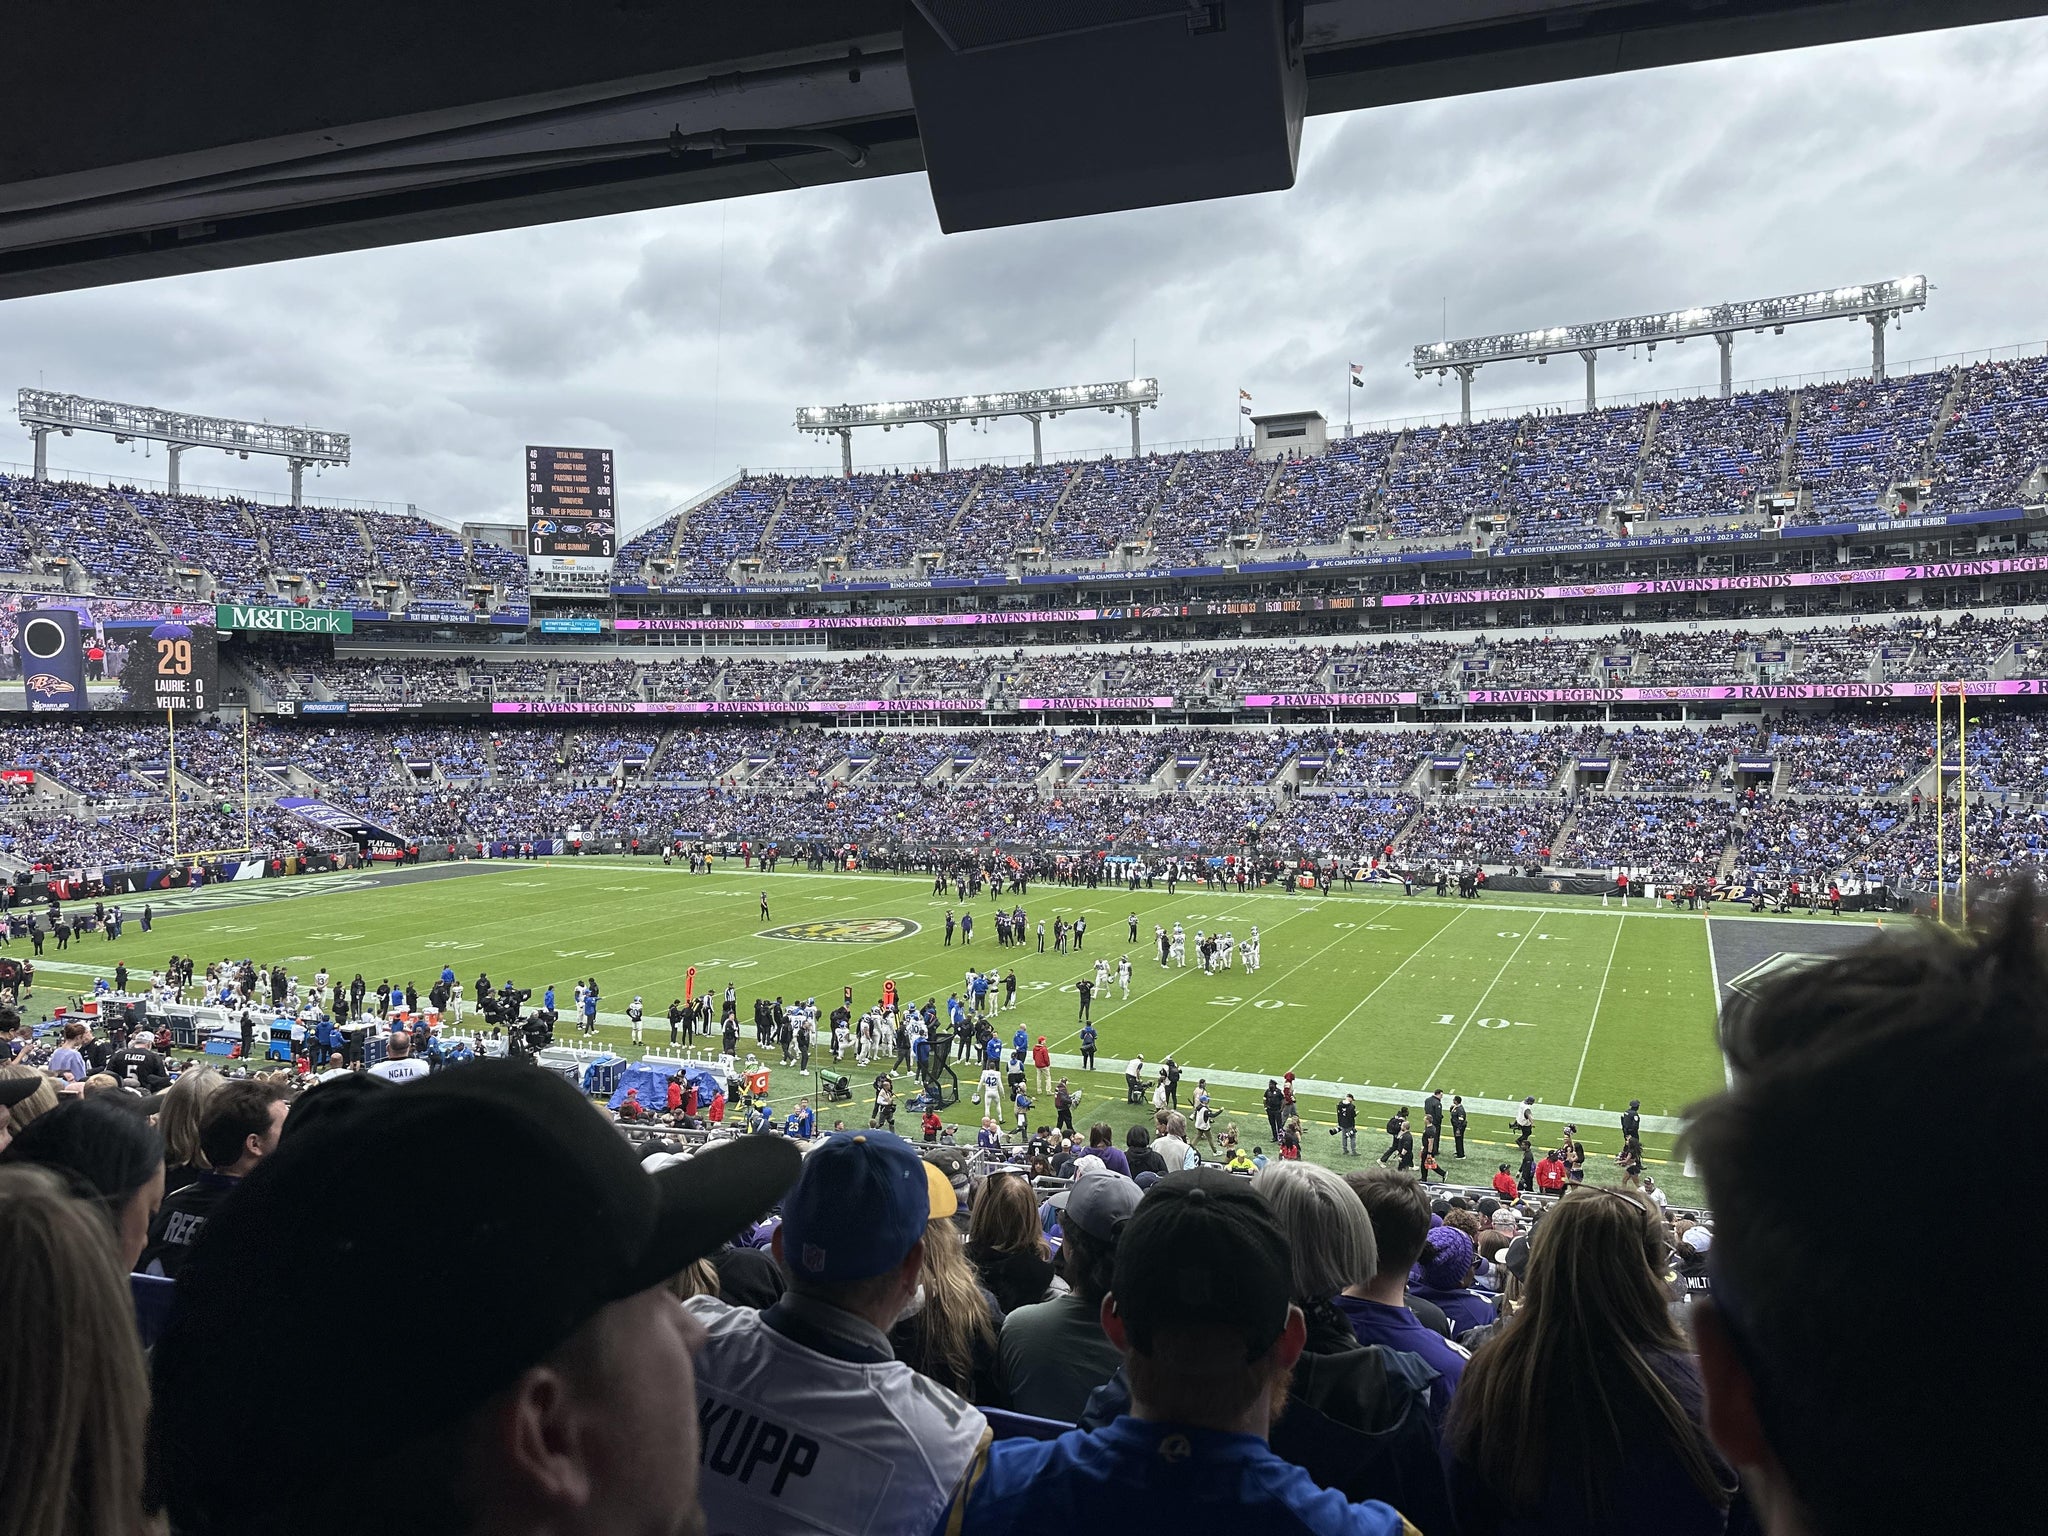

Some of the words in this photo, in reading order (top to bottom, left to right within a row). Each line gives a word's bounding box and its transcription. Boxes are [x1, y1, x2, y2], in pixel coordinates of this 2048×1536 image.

[530, 450, 537, 458] 46
[530, 461, 536, 469] 15
[602, 464, 610, 472] 72
[530, 473, 537, 481] 31
[604, 476, 610, 484] 12
[531, 484, 542, 492] 2/10
[576, 486, 590, 494] YARDS
[597, 487, 610, 495] 3/30
[551, 508, 561, 516] TIME
[566, 508, 592, 516] POSSESSION
[1858, 523, 1876, 532] THANK
[1878, 522, 1888, 530] YOU
[1890, 520, 1921, 530] FRONTLINE
[1922, 517, 1947, 528] HEROES!
[534, 538, 542, 553] 0
[603, 540, 610, 555] 3
[1545, 544, 1583, 552] CHAMPIONS
[1904, 568, 1916, 579] 2
[1924, 562, 1993, 578] RAVENS
[1998, 556, 2048, 574] LEGE
[1811, 573, 1840, 584] PASS
[1851, 570, 1886, 582] CASH
[1637, 583, 1648, 593] 2
[1653, 579, 1713, 592] RAVENS
[1718, 575, 1792, 590] LEGENDS
[1559, 586, 1586, 596] PASS
[1595, 584, 1624, 595] CASH
[1410, 595, 1419, 604] 2
[1423, 592, 1476, 604] RAVENS
[1480, 588, 1544, 601] LEGENDS
[1265, 602, 1282, 612] 15:00
[1283, 602, 1295, 611] QTR
[1296, 601, 1300, 610] 2
[1329, 598, 1354, 609] TIMEOUT
[1362, 597, 1375, 607] 1:35
[1126, 609, 1131, 617] 0
[1174, 607, 1178, 616] 3
[1222, 605, 1226, 614] 2
[1228, 604, 1239, 614] BALL
[1240, 604, 1248, 613] ON
[232, 607, 288, 630] M&T
[290, 611, 340, 632] Bank
[819, 618, 857, 627] RAVENS
[861, 617, 906, 626] LEGENDS
[986, 614, 1026, 623] RAVENS
[1030, 612, 1079, 621] LEGENDS
[650, 621, 692, 629] RAVENS
[696, 620, 744, 629] LEGENDS
[158, 640, 192, 675] 29
[155, 679, 190, 692] LAURIE:
[196, 679, 203, 693] 0
[1725, 687, 1736, 698] 2
[1742, 685, 1807, 699] RAVENS
[1812, 684, 1894, 697] LEGENDS
[2018, 681, 2032, 694] 2
[1271, 696, 1281, 705] 2
[1284, 695, 1334, 705] RAVENS
[1339, 693, 1400, 705] LEGENDS
[1476, 692, 1486, 702] 2
[1490, 690, 1548, 702] RAVENS
[1553, 688, 1623, 701] LEGENDS
[1639, 689, 1668, 699] PASS
[1678, 688, 1710, 698] CASH
[157, 696, 190, 709] VELITA:
[196, 696, 204, 709] 0
[279, 703, 292, 712] 25
[531, 704, 578, 712] RAVENS
[582, 704, 635, 712] LEGENDS
[718, 704, 759, 712] RAVENS
[762, 702, 810, 711] LEGENDS
[889, 701, 930, 710] RAVENS
[933, 700, 982, 710] LEGENDS
[1042, 700, 1050, 708] 2
[1054, 699, 1097, 708] RAVENS
[1101, 698, 1154, 708] LEGENDS
[1431, 1014, 1510, 1029] 10
[127, 1065, 138, 1080] 5
[389, 1068, 414, 1078] NGATA
[756, 1076, 765, 1088] G
[985, 1076, 997, 1087] 42
[163, 1211, 207, 1246] REE
[1684, 1276, 1711, 1288] MILT
[700, 1397, 820, 1498] KUPP
